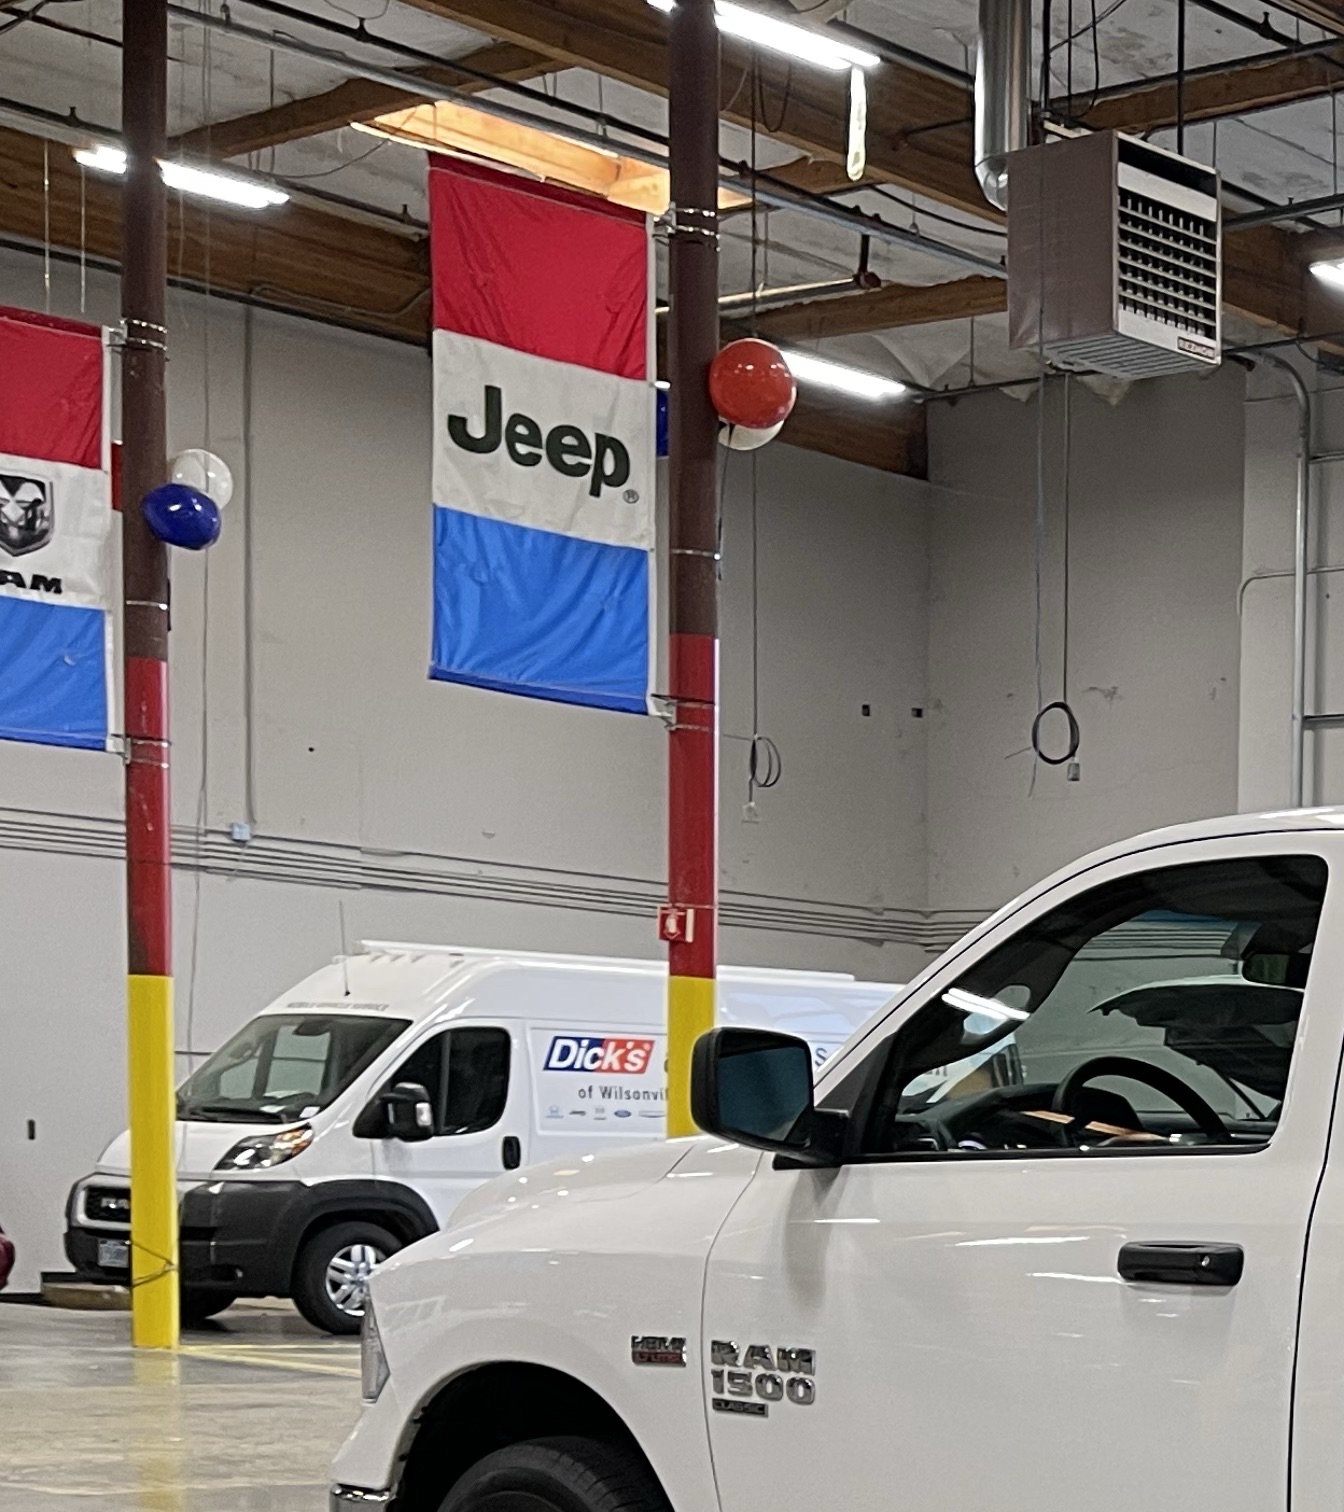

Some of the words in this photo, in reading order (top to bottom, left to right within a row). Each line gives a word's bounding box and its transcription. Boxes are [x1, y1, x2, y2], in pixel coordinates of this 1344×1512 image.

[447, 385, 631, 498] Jeep
[0, 569, 63, 595] AM
[548, 1038, 647, 1072] Dick's
[578, 1085, 594, 1100] of
[599, 1085, 669, 1101] Wilsonvil
[711, 1339, 817, 1376] RAM
[711, 1368, 816, 1405] 1500
